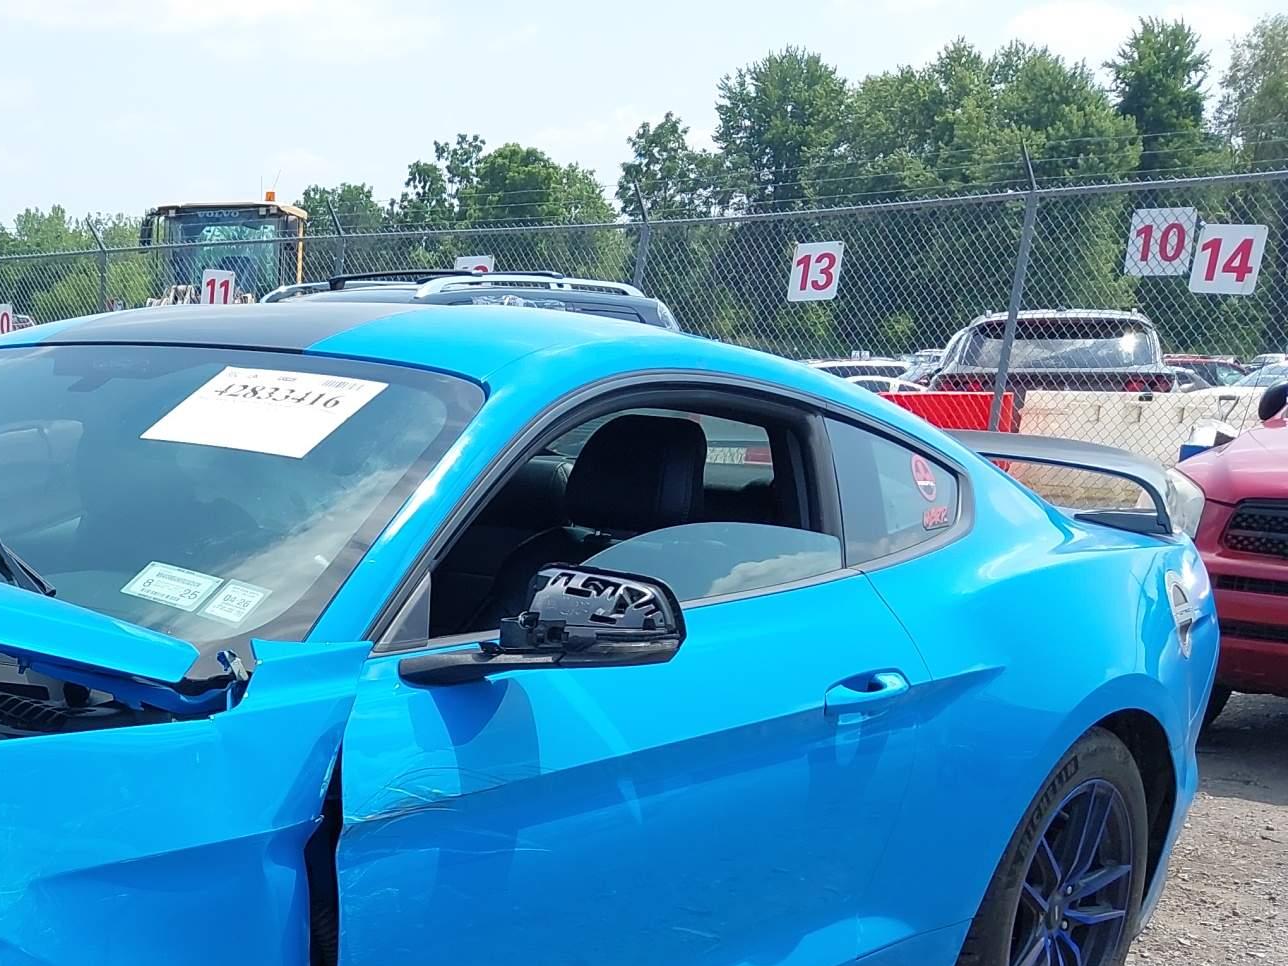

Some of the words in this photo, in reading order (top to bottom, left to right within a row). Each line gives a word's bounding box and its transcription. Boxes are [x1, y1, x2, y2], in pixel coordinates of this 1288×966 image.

[197, 209, 240, 218] VOLVO
[1135, 222, 1187, 263] 10
[795, 252, 837, 292] 13
[1200, 237, 1254, 283] 14
[206, 278, 230, 304] 11
[214, 383, 345, 409] 42833416
[179, 588, 200, 600] 25
